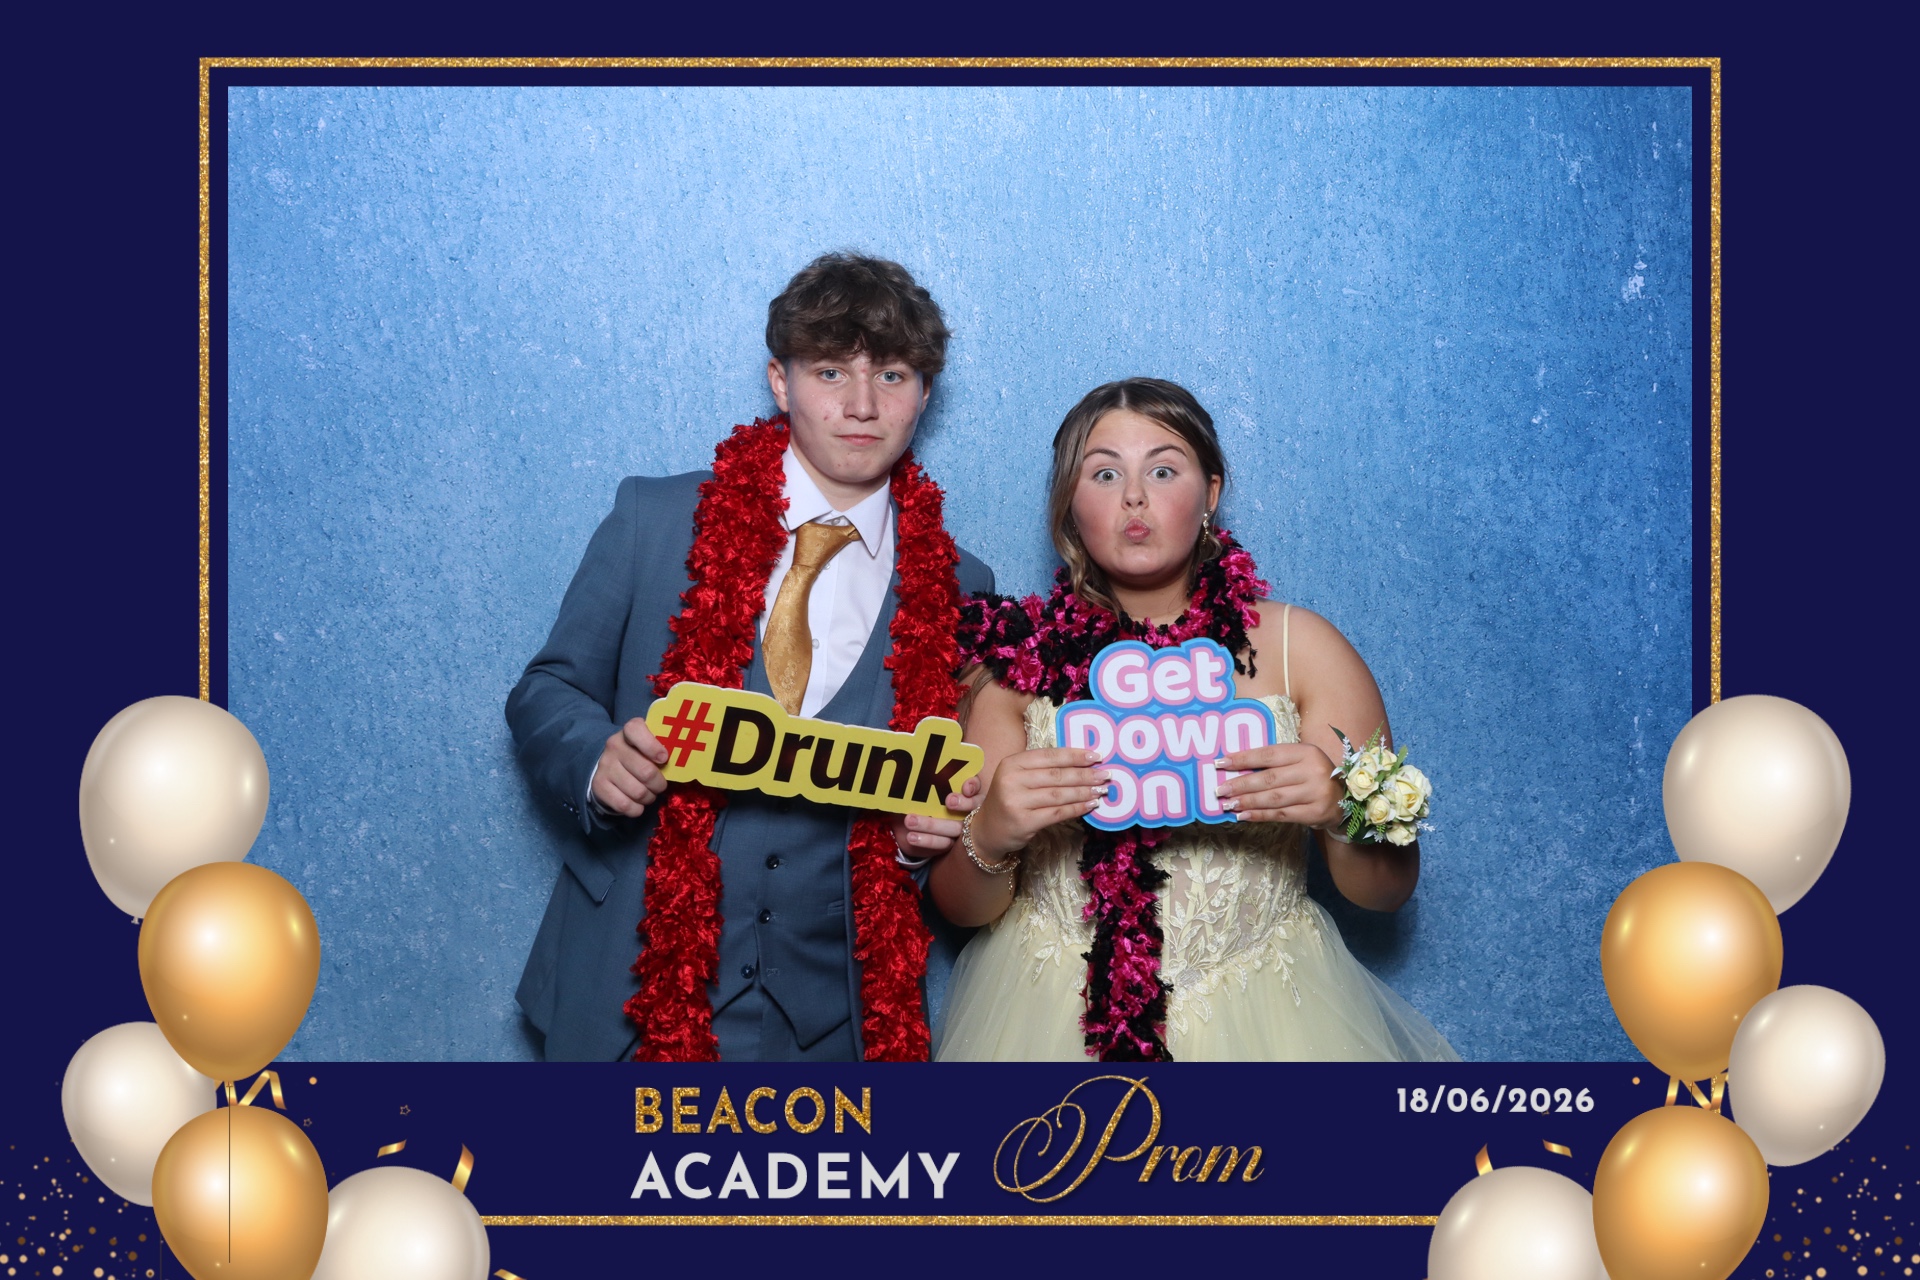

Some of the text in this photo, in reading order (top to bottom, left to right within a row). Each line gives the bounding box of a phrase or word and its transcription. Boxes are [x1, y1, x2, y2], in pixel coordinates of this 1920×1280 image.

[1102, 651, 1223, 703] Get
[654, 698, 970, 807] #Drunk
[1069, 712, 1264, 762] Down
[1099, 768, 1182, 818] On
